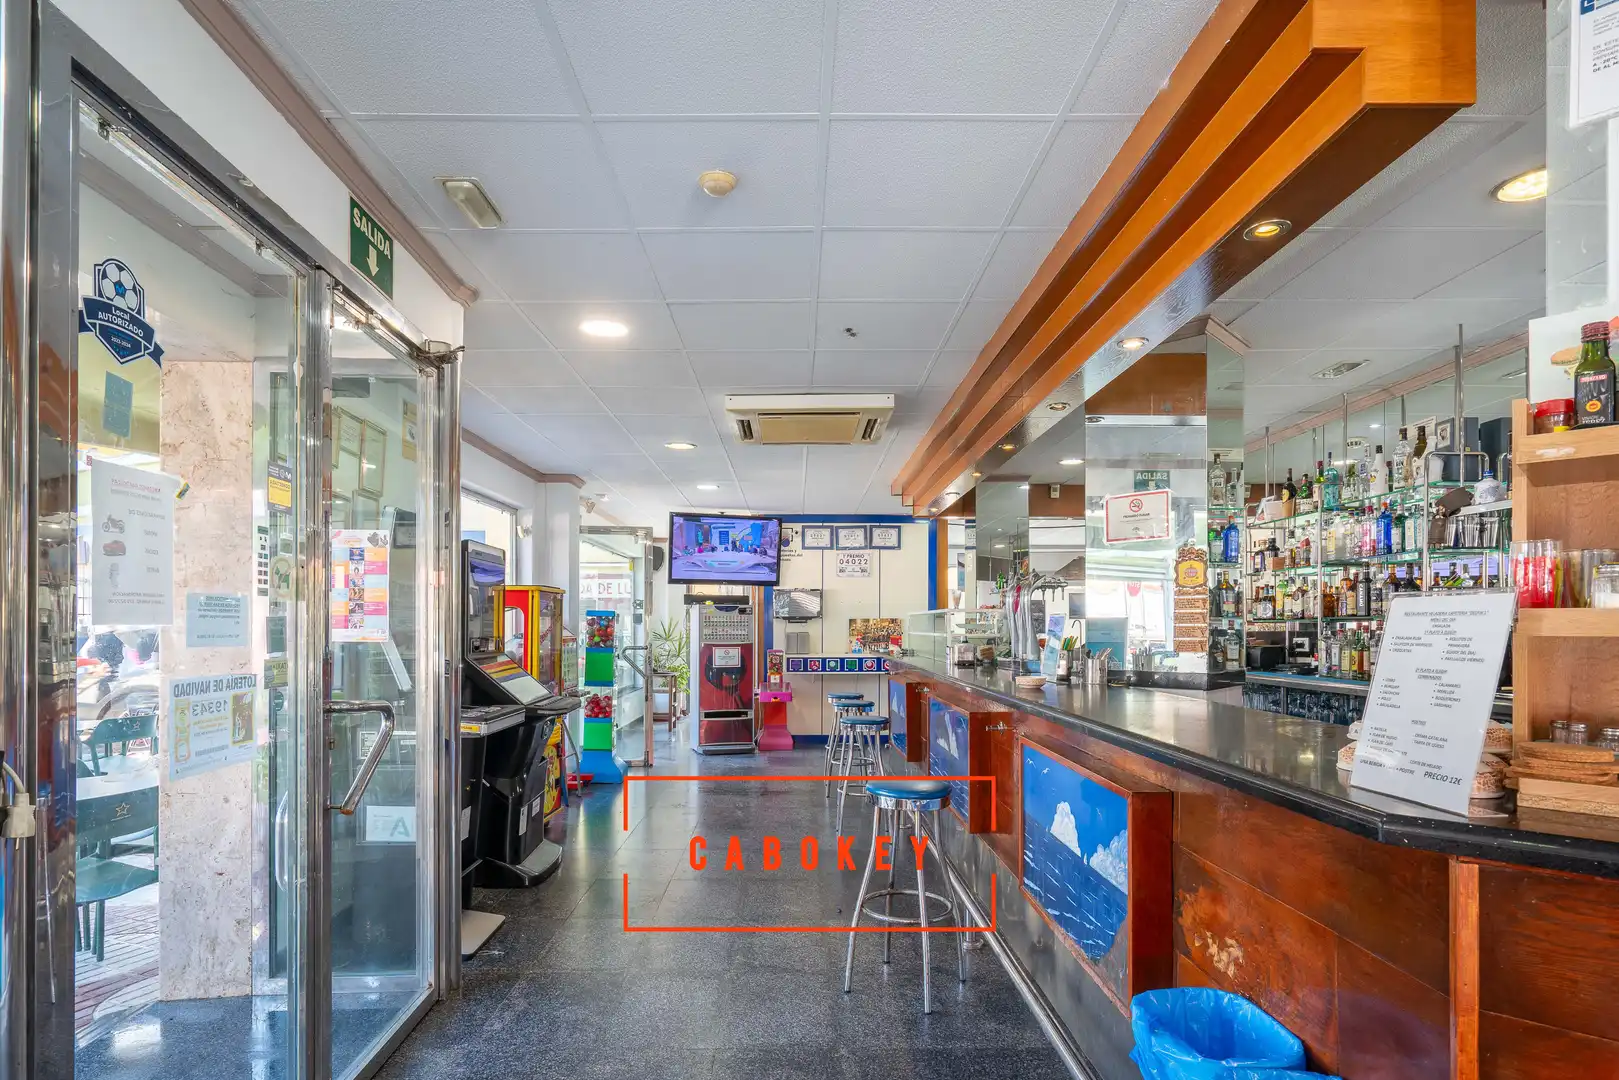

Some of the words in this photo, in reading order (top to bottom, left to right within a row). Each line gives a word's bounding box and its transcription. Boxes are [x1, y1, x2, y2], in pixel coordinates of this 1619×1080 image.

[353, 207, 391, 260] SALIDA
[112, 306, 130, 321] Local
[98, 311, 144, 337] AUTORIZADO
[598, 582, 613, 595] DE
[1368, 760, 1383, 768] BEBIDA
[1398, 767, 1416, 775] POSTRE
[1423, 770, 1449, 782] PRECIO
[1449, 776, 1463, 786] 12€
